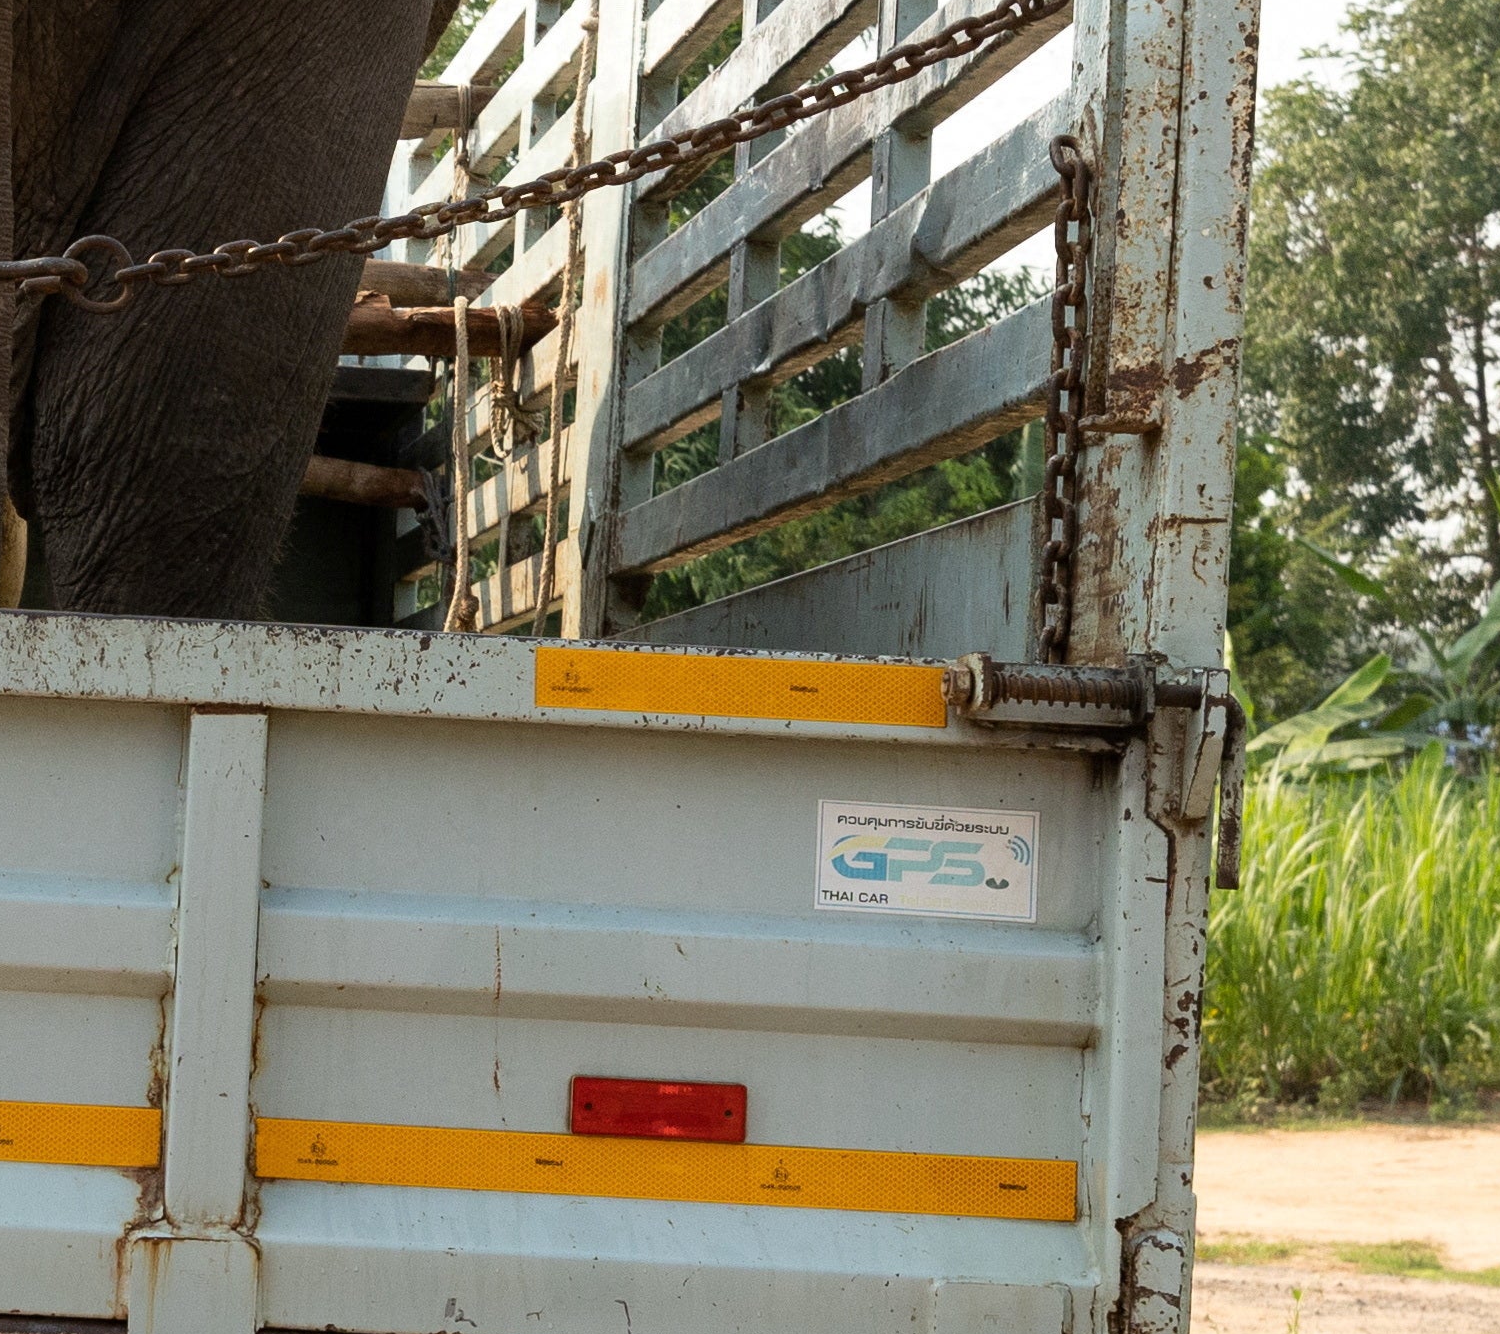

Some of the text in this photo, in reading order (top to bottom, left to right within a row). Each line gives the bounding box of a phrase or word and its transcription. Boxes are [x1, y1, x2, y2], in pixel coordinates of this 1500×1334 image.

[837, 814, 1009, 835] ควบคุมการขับขี่ด้วยระบบ
[828, 836, 985, 887] GPS
[822, 890, 853, 902] THAI
[858, 892, 889, 904] CAR
